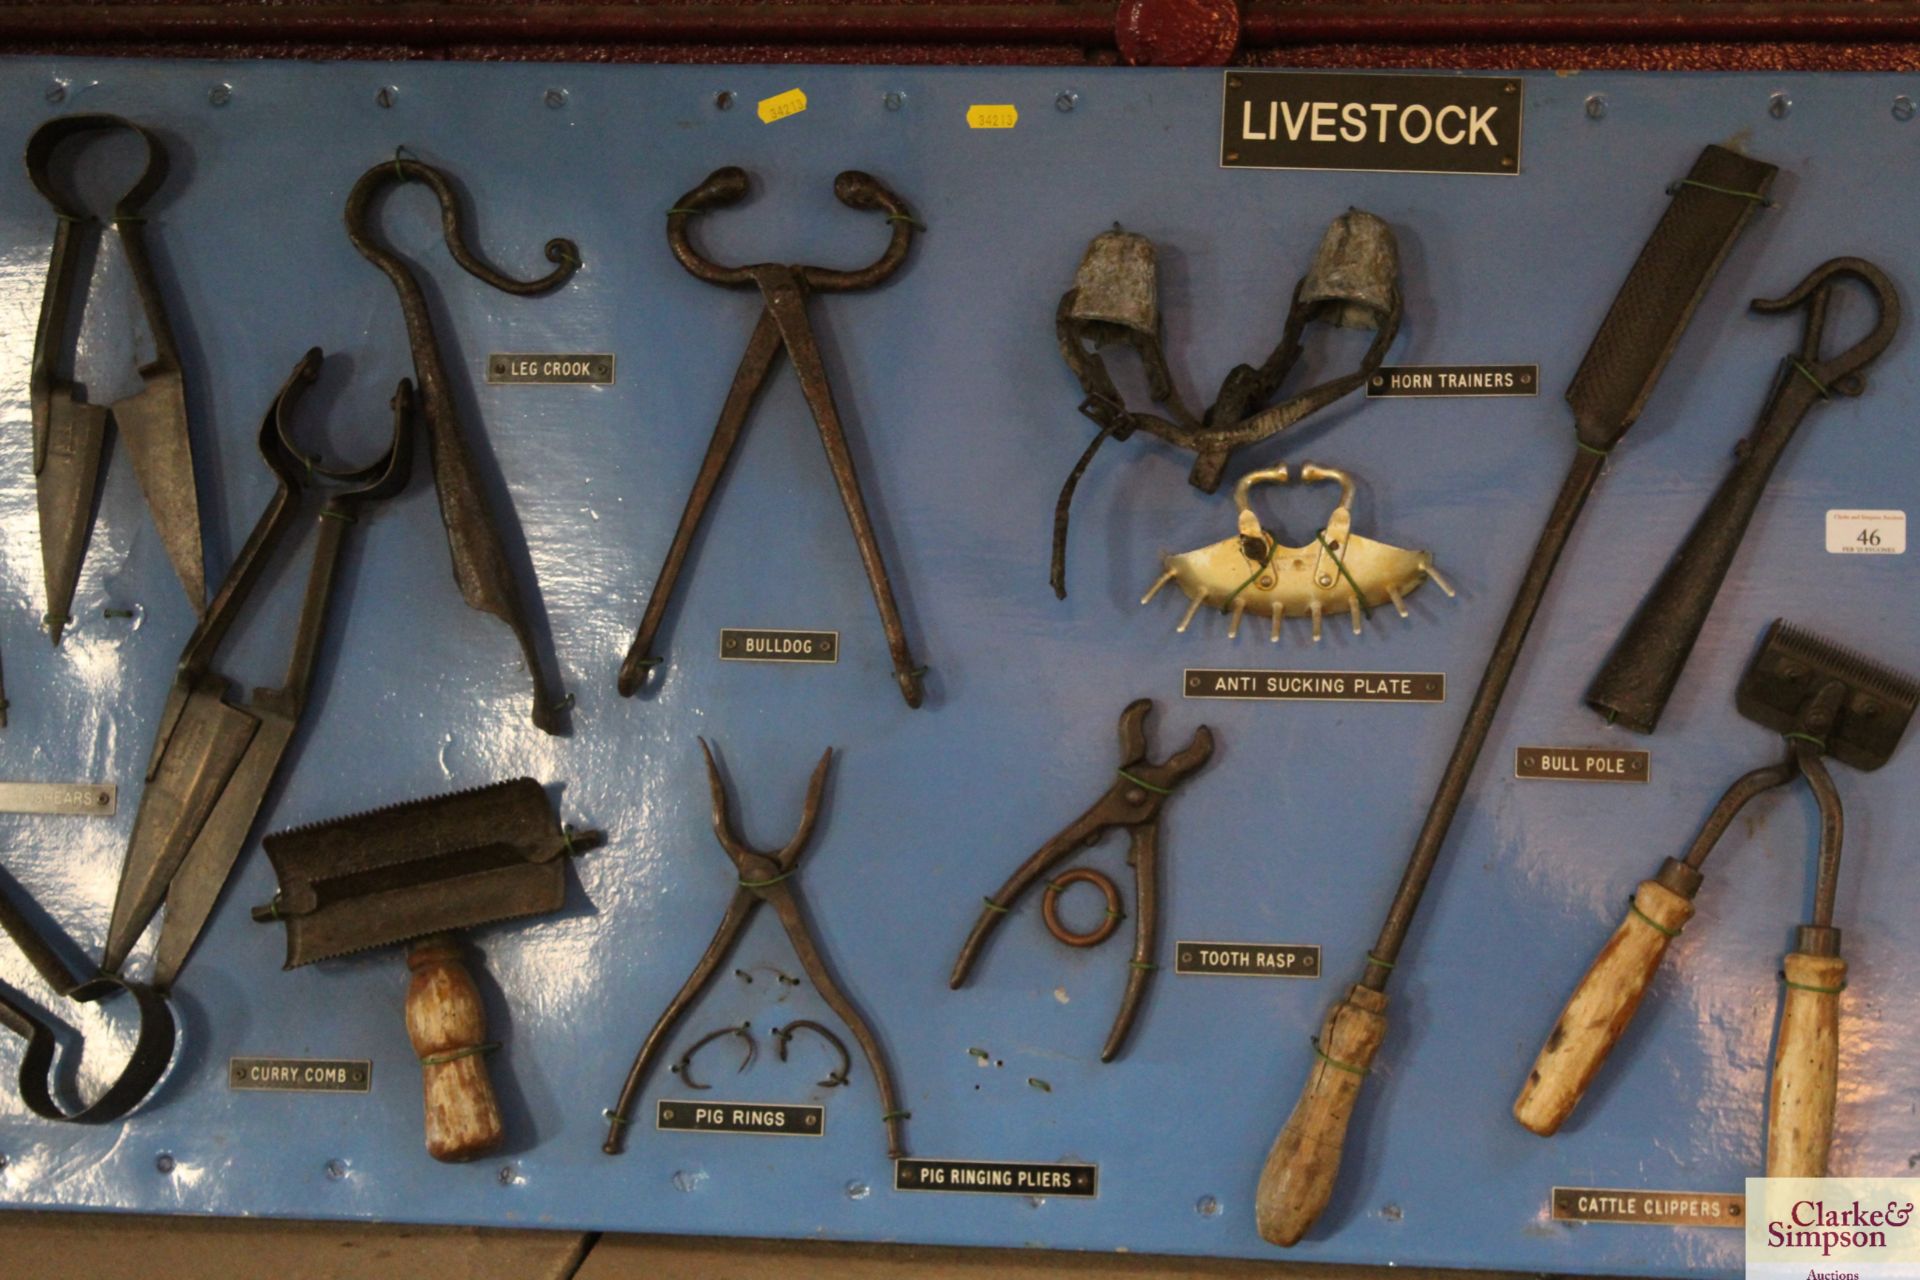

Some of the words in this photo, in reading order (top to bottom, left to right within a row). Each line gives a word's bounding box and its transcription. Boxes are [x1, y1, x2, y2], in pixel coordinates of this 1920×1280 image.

[977, 114, 1013, 127] 34213
[1243, 101, 1499, 146] LIVESTOCK
[511, 361, 538, 376] LEG
[543, 361, 591, 376] CROOK
[1391, 374, 1433, 388] HORN
[1438, 372, 1514, 388] TRAINERS
[1856, 528, 1881, 546] 46
[746, 638, 812, 653] BULLDOG
[1215, 677, 1257, 691] ANTI
[1267, 677, 1345, 693] SUCKING
[1354, 679, 1412, 694] PLATE
[1541, 755, 1580, 772] BULL
[1586, 757, 1625, 773] POLE
[1200, 950, 1250, 967] TOOTH
[1256, 952, 1296, 968] RASP
[250, 1066, 299, 1081] CURRY
[304, 1067, 346, 1083] COMB
[695, 1108, 724, 1124] PIG
[732, 1110, 786, 1127] RINGS
[920, 1168, 945, 1184] PIG
[950, 1169, 1012, 1186] RINGING
[1017, 1171, 1072, 1187] PLIERS
[1578, 1197, 1637, 1214] CATTLE
[1643, 1199, 1721, 1217] CLIPPERS
